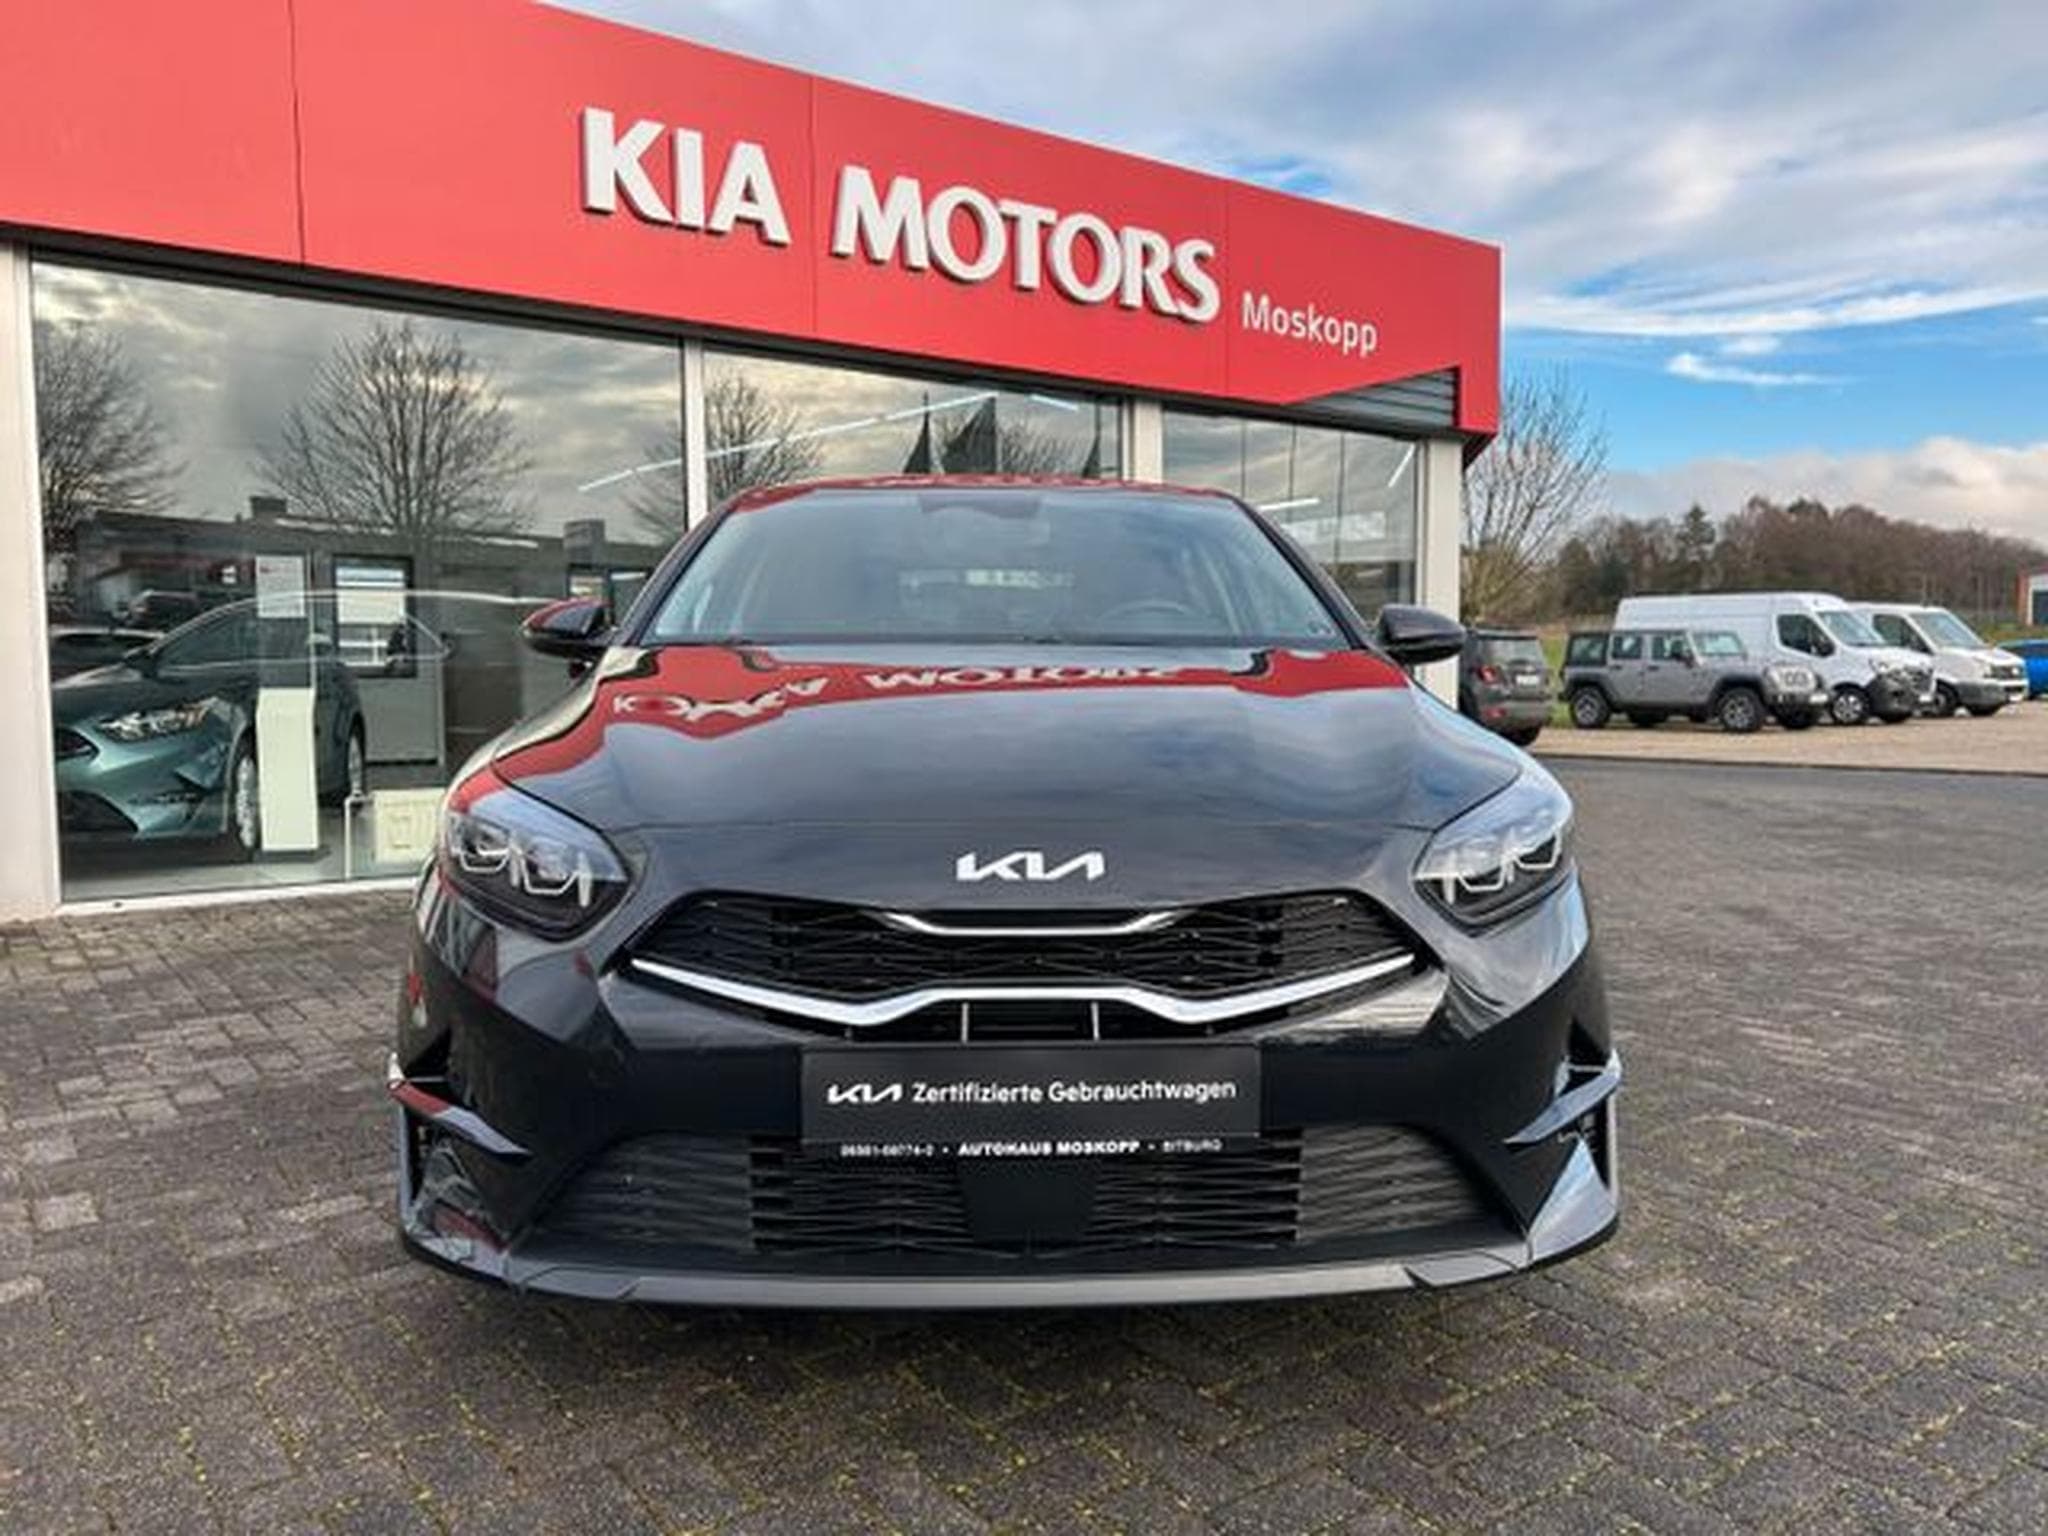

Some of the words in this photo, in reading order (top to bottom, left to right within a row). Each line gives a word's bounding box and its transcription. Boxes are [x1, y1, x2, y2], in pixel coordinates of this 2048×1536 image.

[580, 106, 792, 248] KIA
[832, 164, 1221, 324] MOTORS
[1242, 290, 1378, 358] Moskopp
[956, 851, 1105, 881] KIA
[827, 1083, 903, 1105] KIA
[912, 1080, 1043, 1104] Zertifizierte
[1047, 1079, 1237, 1105] Gebrauchtwagen
[957, 1141, 1052, 1156] AUTOHAUS
[1056, 1139, 1140, 1155] MOSKOPP
